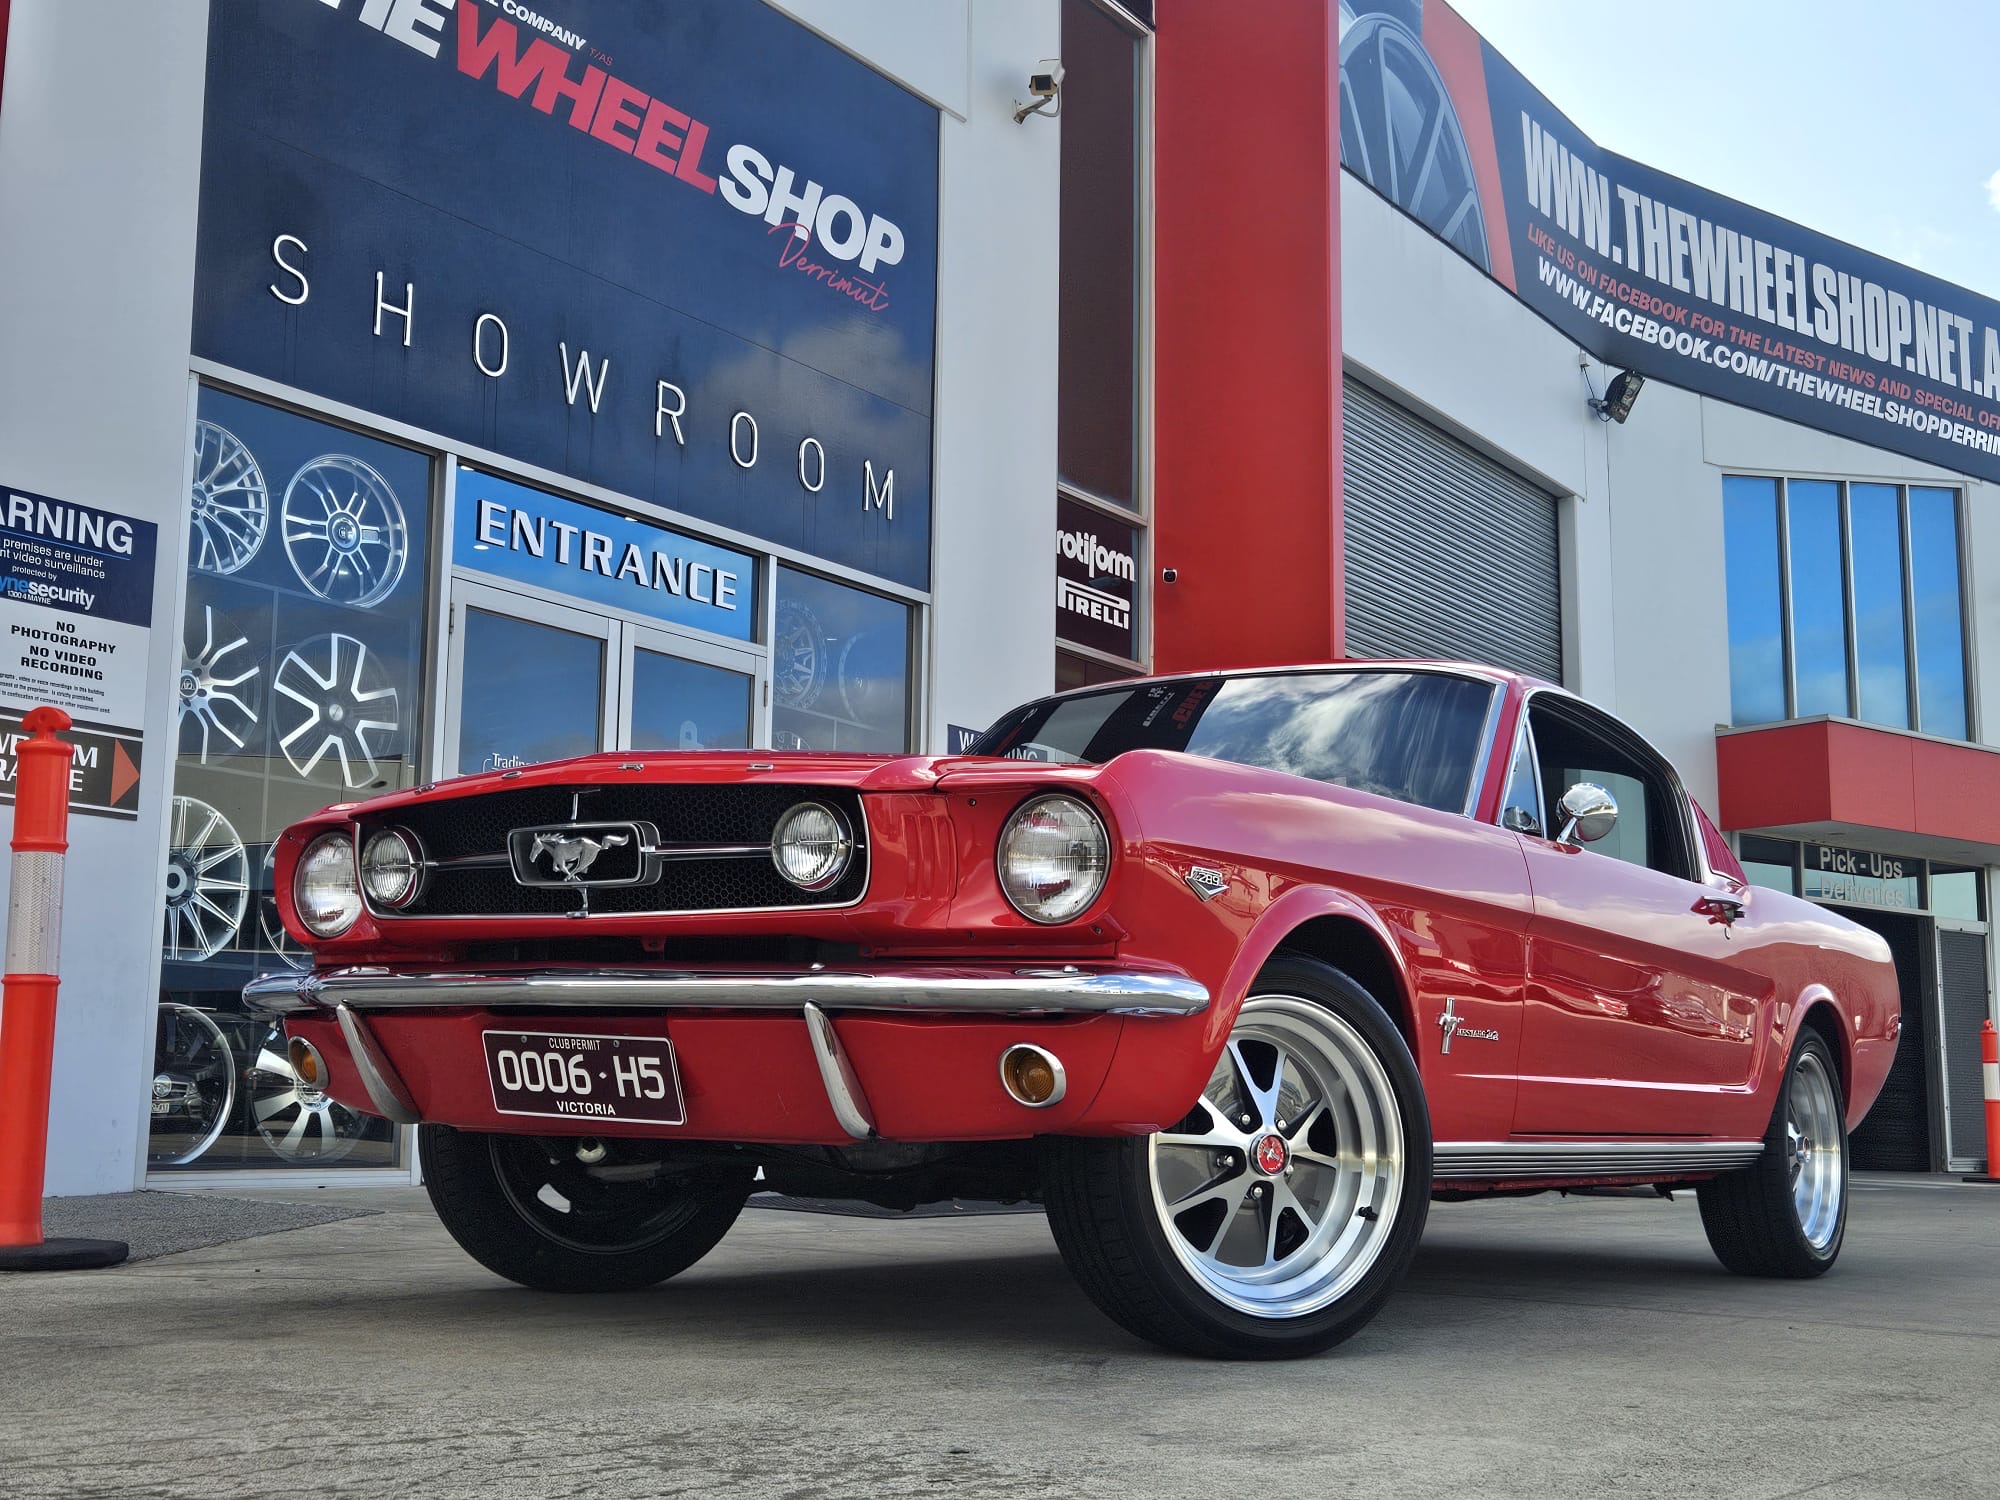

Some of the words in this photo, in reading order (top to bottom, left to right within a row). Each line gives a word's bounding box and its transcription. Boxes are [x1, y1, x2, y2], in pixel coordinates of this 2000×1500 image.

[503, 0, 587, 50] COMPANY
[768, 223, 889, 311] Derrimut
[1527, 223, 1555, 257] LIKE
[1557, 246, 1575, 270] US
[1577, 260, 1598, 286] ON
[1599, 273, 1687, 326] FACEBOOK
[1690, 311, 1725, 339] FOR
[1729, 324, 1761, 351] THE
[1764, 335, 1826, 372] LATEST
[1828, 360, 1876, 389] NEWS
[1878, 377, 1911, 401] AND
[1914, 388, 1974, 423] SPECIAL
[269, 233, 894, 521] SHOWROOM
[3, 538, 52, 556] premises
[54, 548, 71, 561] are
[74, 553, 104, 568] under
[13, 550, 42, 565] video
[44, 558, 106, 579] surveillance
[477, 499, 738, 611] ENTRANCE
[1056, 529, 1136, 582] rotiform
[12, 565, 47, 578] protected
[48, 572, 57, 582] by
[1057, 575, 1131, 630] PIRELLI
[11, 624, 117, 654] PHOTOGRAPHY
[56, 621, 76, 634] NO
[21, 656, 104, 681] RECORDING
[29, 645, 50, 658] NO
[55, 649, 97, 667] VIDEO
[1819, 846, 1857, 874] Pick
[1870, 852, 1903, 883] Ups
[548, 1037, 570, 1049] CLUB
[571, 1038, 601, 1051] PERMIT
[556, 1100, 617, 1116] VICTORIA
